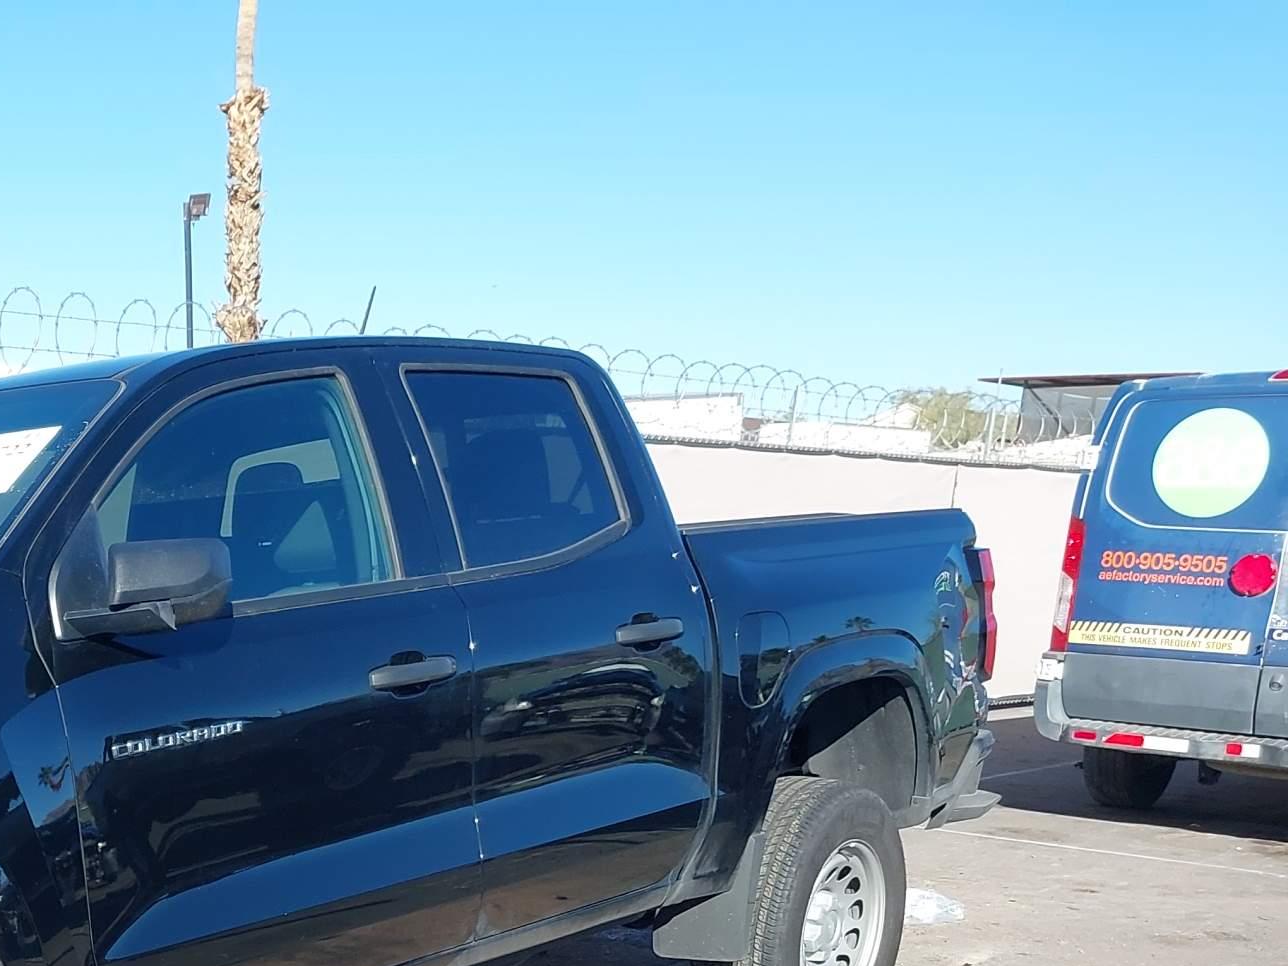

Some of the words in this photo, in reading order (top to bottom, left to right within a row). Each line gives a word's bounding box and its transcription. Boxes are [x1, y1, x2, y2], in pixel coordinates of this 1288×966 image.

[1098, 569, 1225, 587] aefactoryservice.com
[1122, 626, 1184, 637] CAUTION
[1081, 633, 1096, 642] THIS
[1098, 634, 1126, 644] VEHICLE
[1129, 637, 1157, 646] MAKES
[1160, 638, 1202, 649] FREQUENT
[1205, 641, 1233, 651] STOPS
[112, 721, 243, 760] COLORADO
